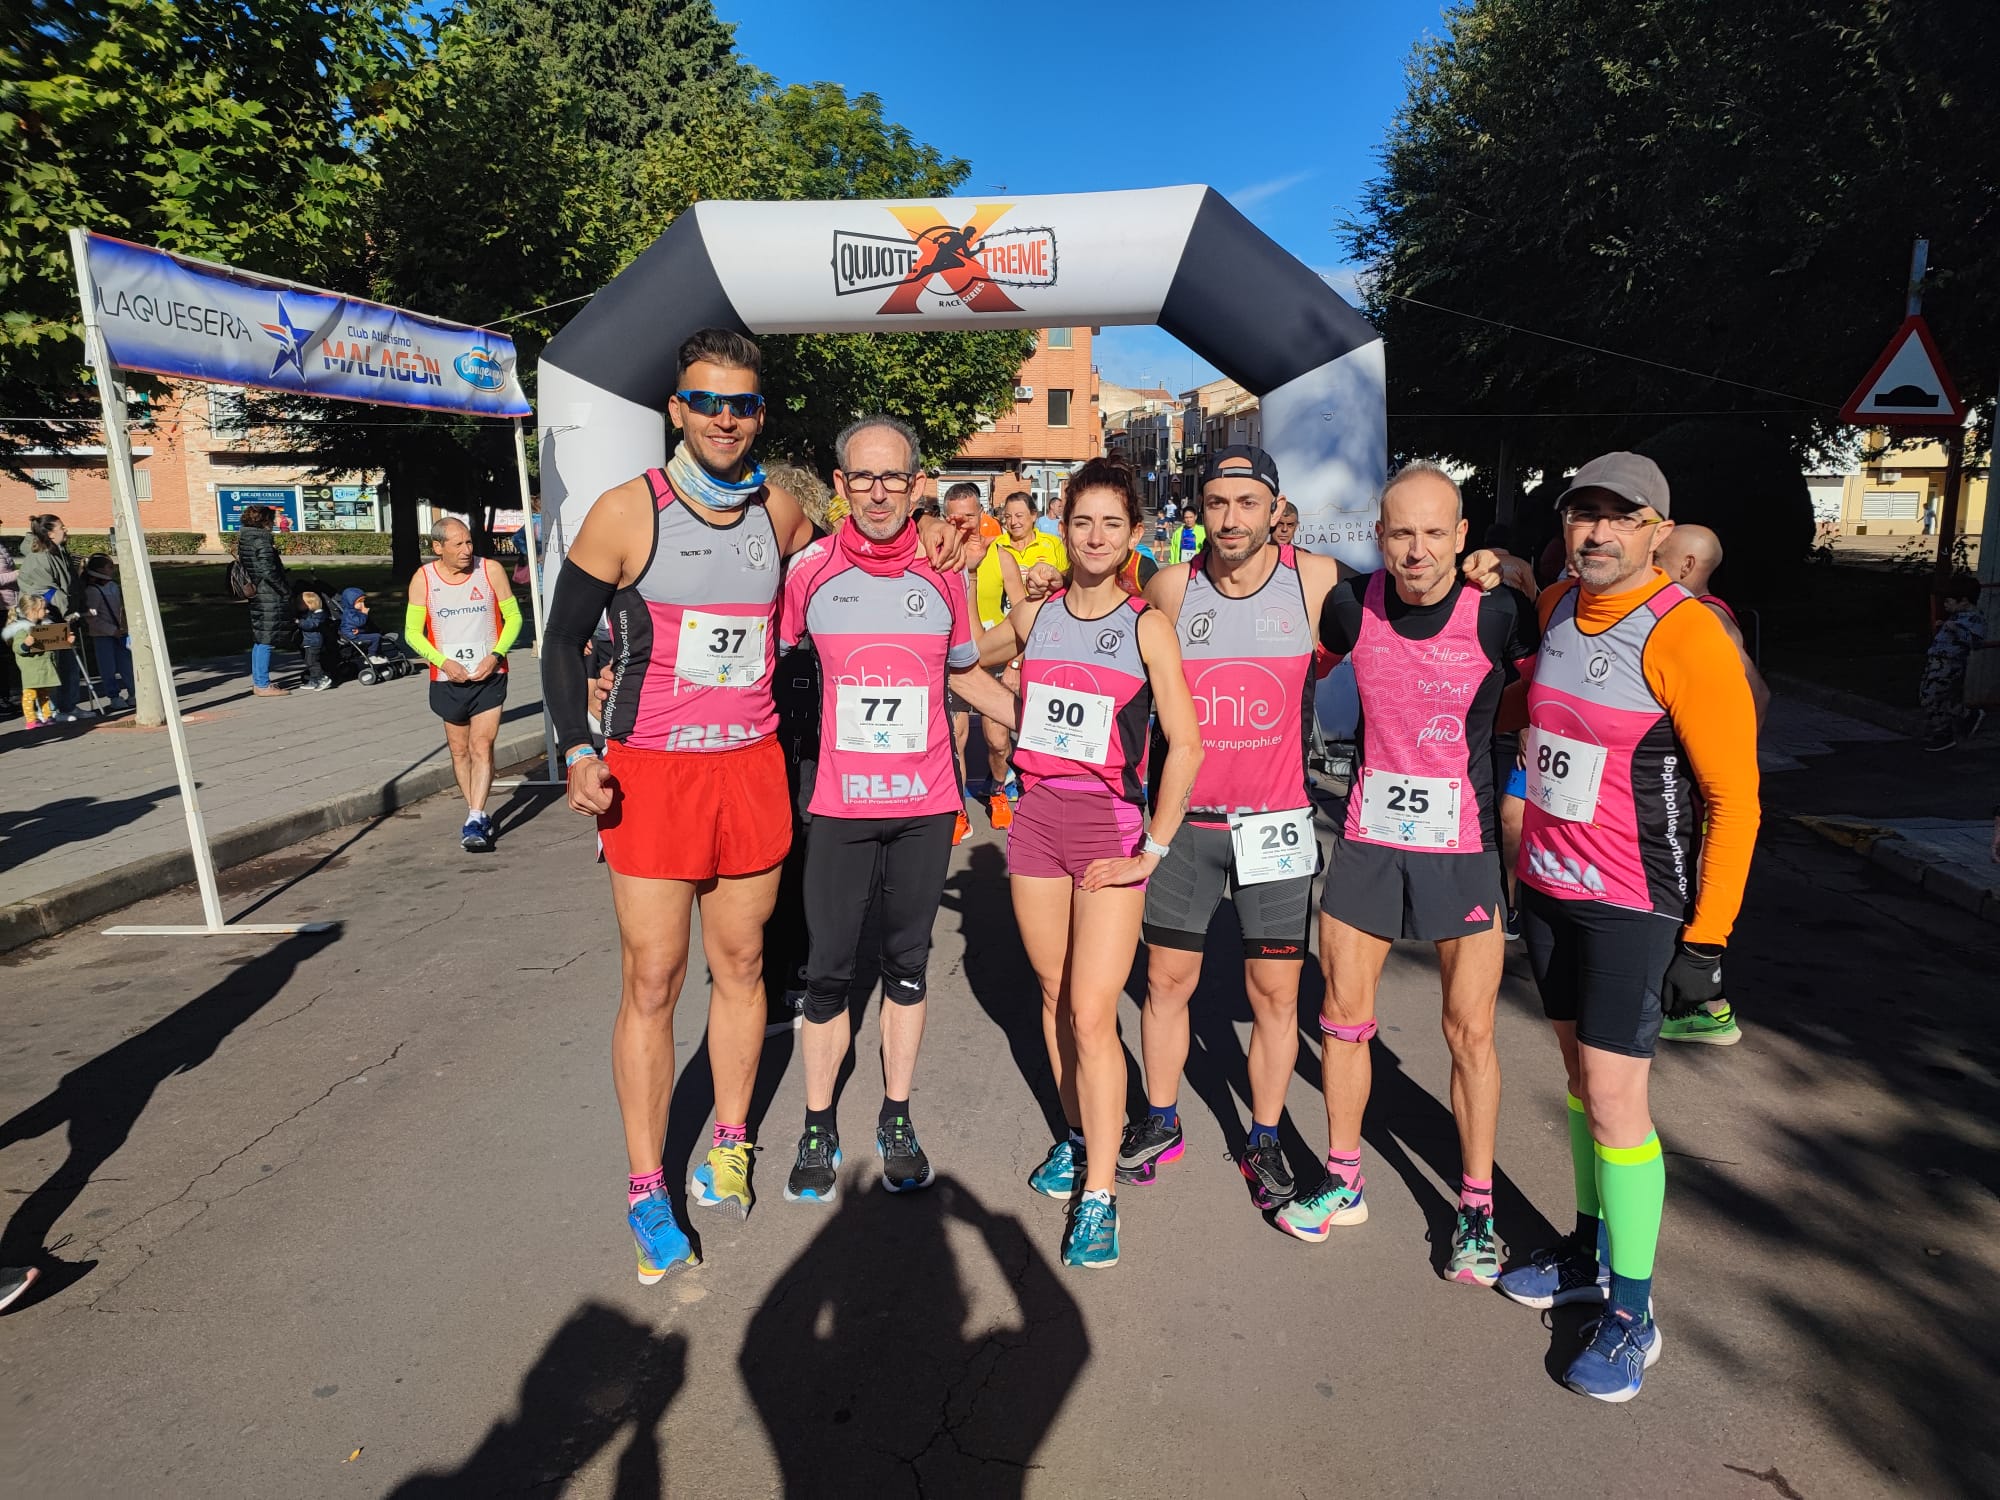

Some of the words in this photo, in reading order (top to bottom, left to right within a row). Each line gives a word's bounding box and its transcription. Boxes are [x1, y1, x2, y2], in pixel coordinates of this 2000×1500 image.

[840, 243, 918, 286] QUIJOTE
[939, 299, 961, 308] RACE
[962, 281, 985, 304] SERIES
[347, 325, 369, 339] Club
[371, 330, 412, 347] Atletismo
[1293, 532, 1341, 545] UDAD
[1299, 521, 1362, 532] UTACION
[455, 648, 474, 660] 43
[708, 628, 747, 654] 37
[1417, 679, 1470, 697] BESAME
[861, 698, 902, 722] 77
[1047, 698, 1085, 728] 90
[1537, 744, 1571, 779] 86
[1386, 785, 1429, 814] 25
[1259, 822, 1299, 850] 26
